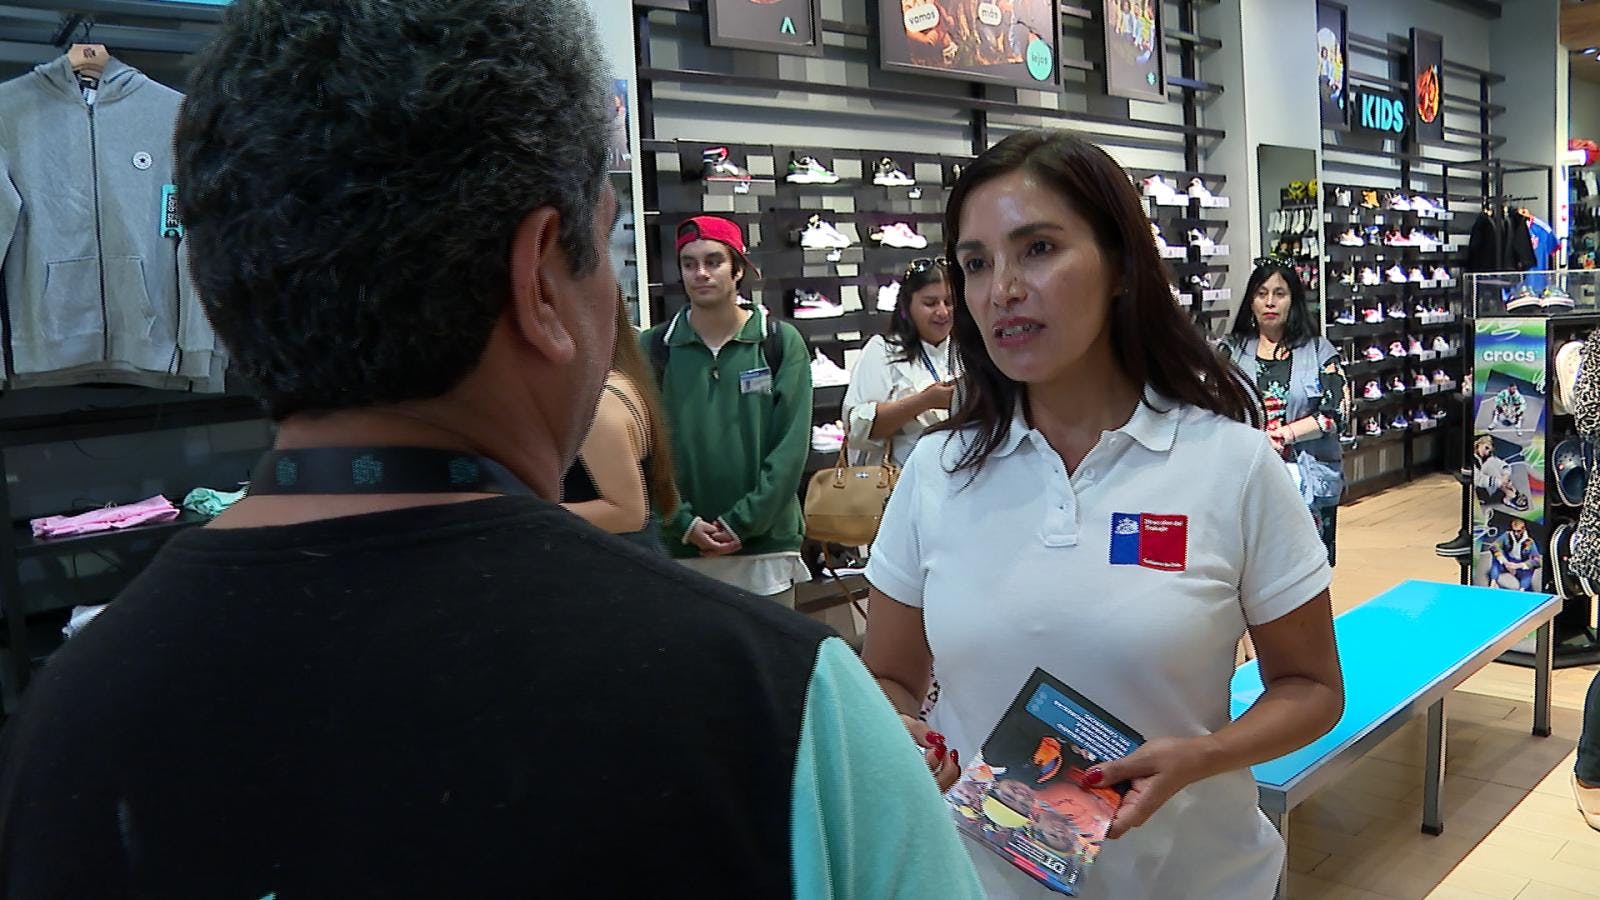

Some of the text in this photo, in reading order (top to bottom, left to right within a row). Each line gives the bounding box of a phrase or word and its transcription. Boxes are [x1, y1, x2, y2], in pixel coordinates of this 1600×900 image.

[909, 11, 936, 24] vamos
[1362, 93, 1404, 133] KIDS
[1483, 350, 1535, 362] crocs
